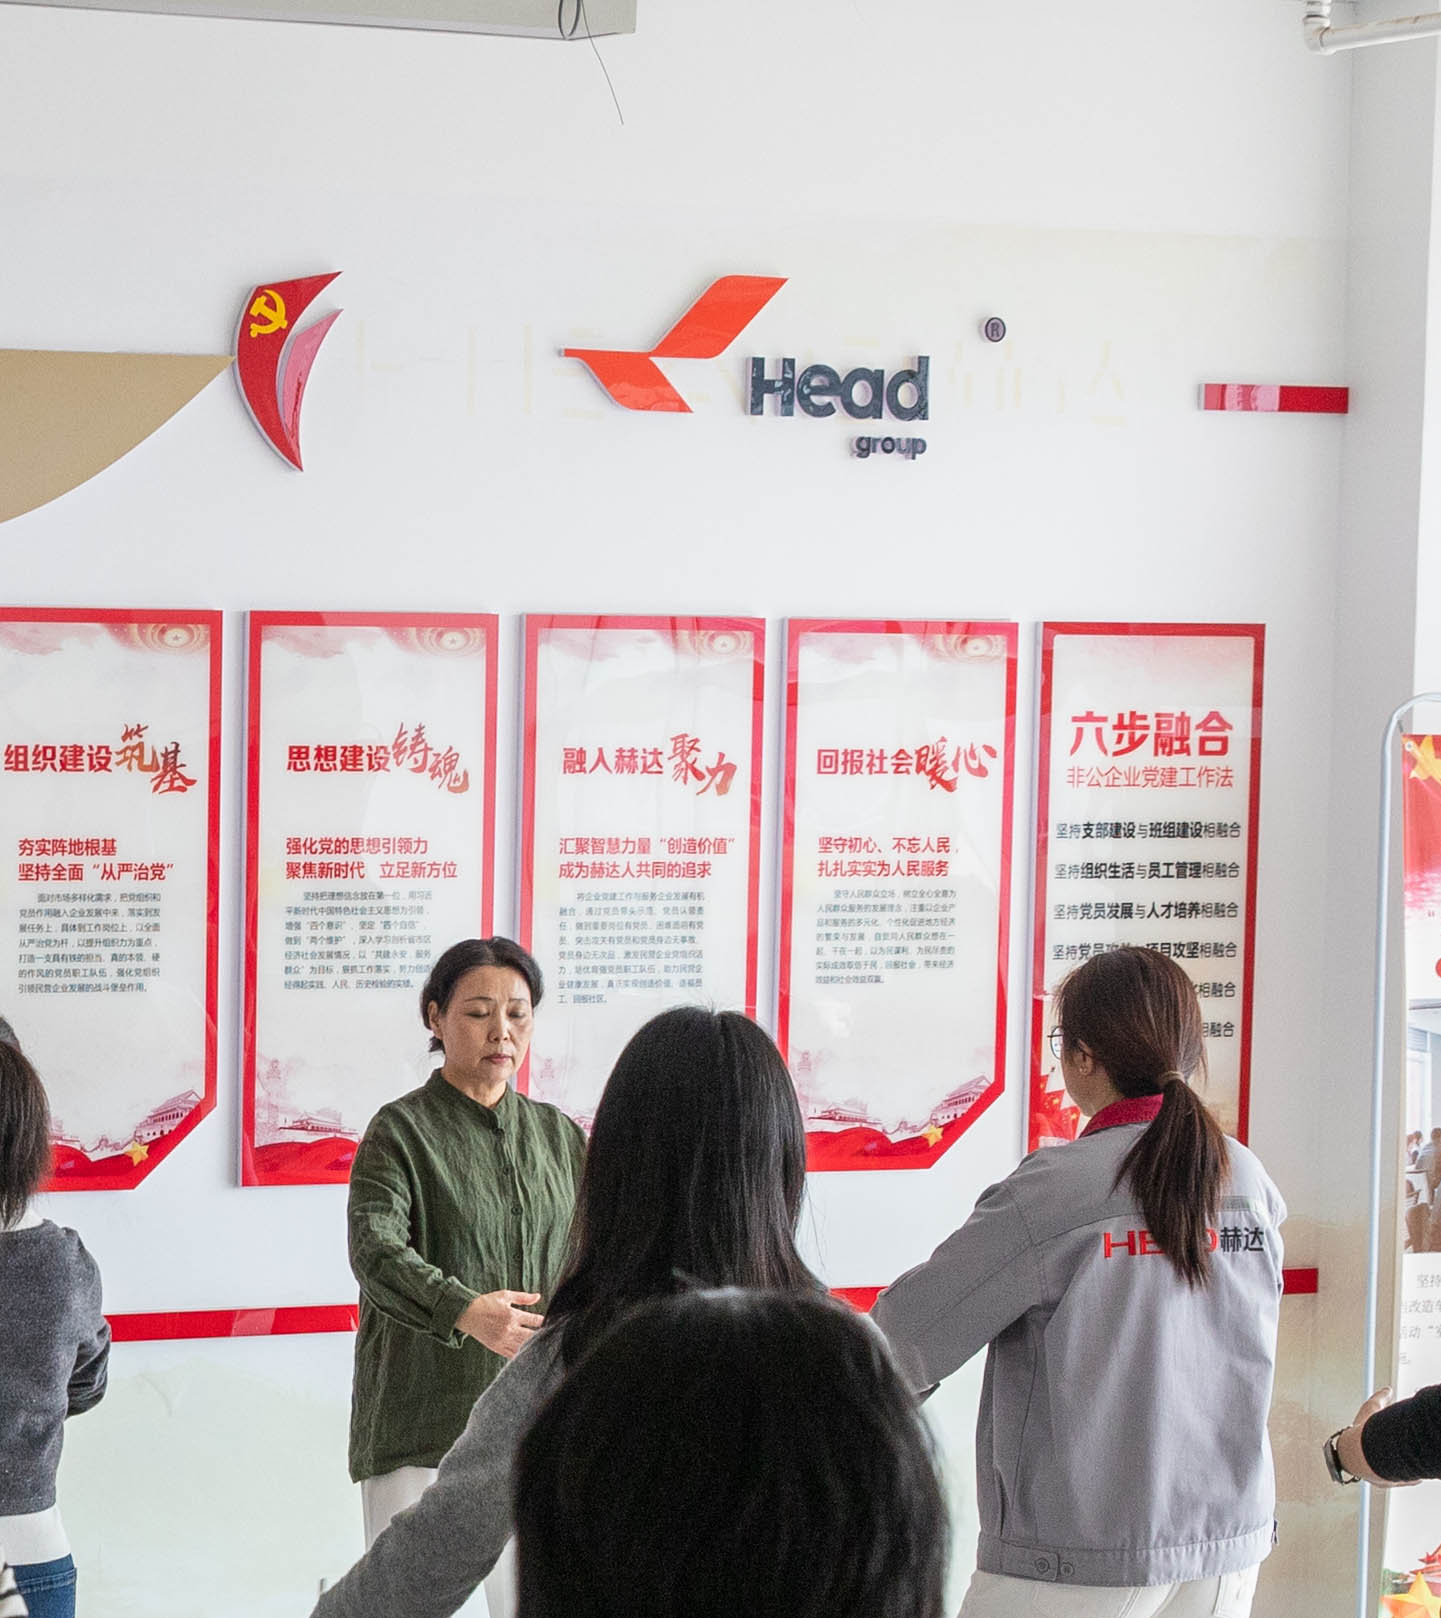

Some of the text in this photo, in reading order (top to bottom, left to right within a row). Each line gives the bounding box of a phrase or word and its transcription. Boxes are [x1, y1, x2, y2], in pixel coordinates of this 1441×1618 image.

[748, 355, 930, 421] Head
[855, 436, 927, 460] group
[1070, 710, 1233, 757] 六步融合
[562, 733, 737, 795] 融入赫达聚力
[1066, 765, 1233, 788] 非公企业党建工作法
[1056, 821, 1240, 839] 坚持支部建设与班组建设相融合
[18, 838, 116, 856] 夯实阵地根基
[286, 837, 427, 854] 强化党的思想引领力
[18, 863, 173, 881] 坚持全面“从严治党”
[286, 861, 457, 879] 聚焦新时代 立足新方位
[559, 861, 711, 878] 成为赫达人共同的追求
[818, 860, 948, 877] 扎扎实实为人民服务
[1054, 862, 1239, 879] 坚持组织生活与员工管理相融合
[1053, 902, 1238, 919] 坚持党员发展与人才培养相融合
[1220, 1226, 1264, 1252] 赫达
